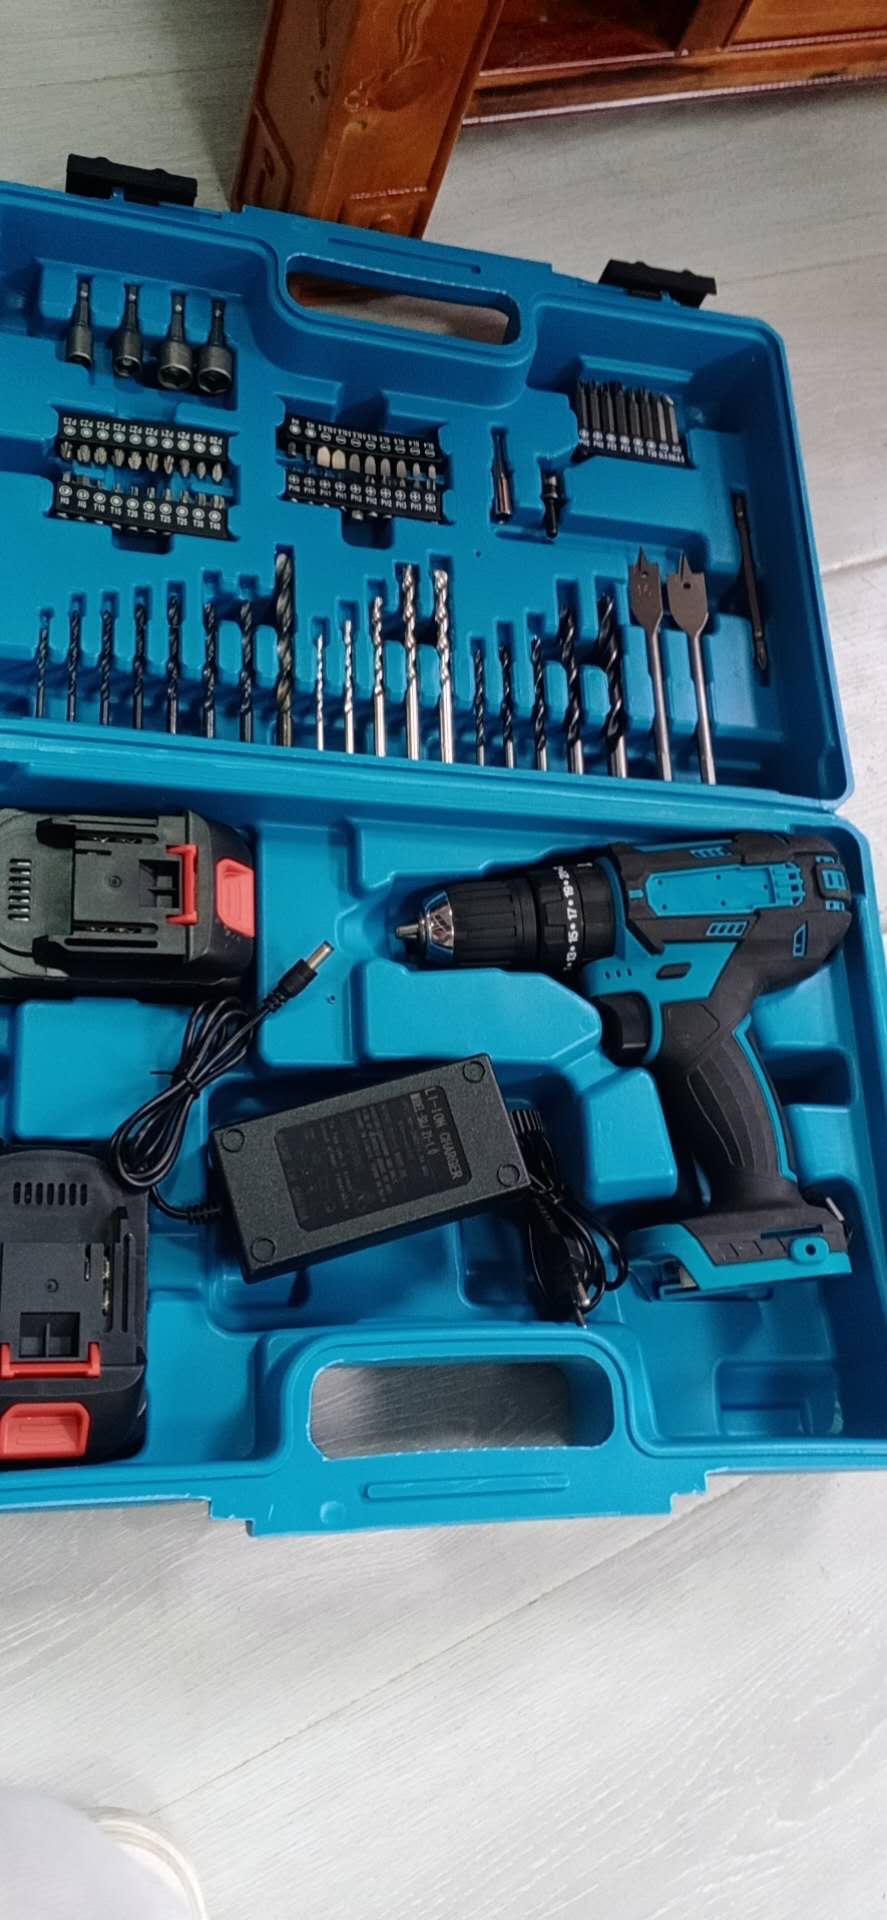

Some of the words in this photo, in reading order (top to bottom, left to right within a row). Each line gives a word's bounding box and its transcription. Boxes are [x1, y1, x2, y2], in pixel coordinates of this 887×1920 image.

[94, 503, 105, 512] T10
[563, 885, 574, 898] 19
[566, 907, 578, 921] 17
[568, 931, 579, 944] 15
[566, 951, 577, 962] 13
[425, 1087, 446, 1130] LI-ION
[439, 1132, 464, 1180] CHARGER
